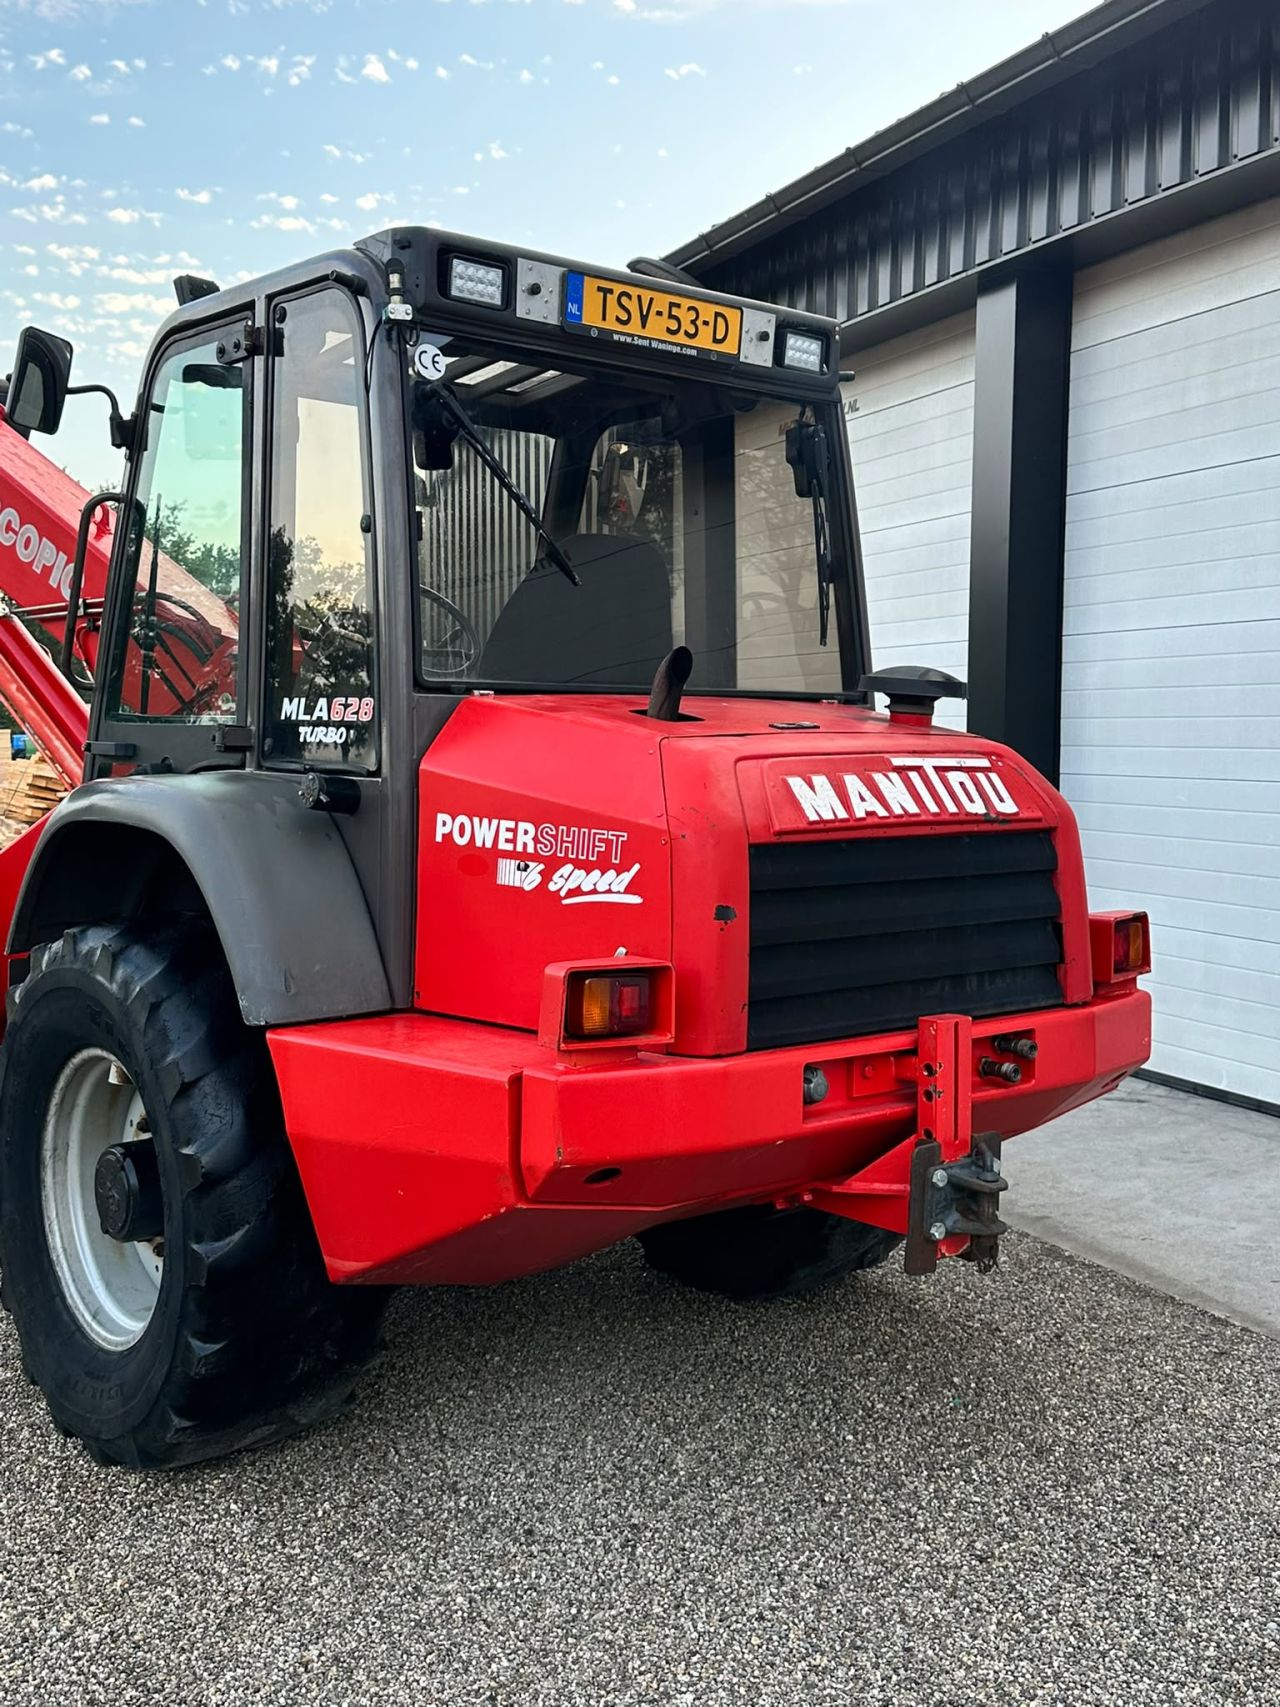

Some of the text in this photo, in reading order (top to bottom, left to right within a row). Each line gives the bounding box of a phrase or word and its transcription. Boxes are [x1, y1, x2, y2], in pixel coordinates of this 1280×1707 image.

[567, 302, 581, 315] NL
[597, 285, 730, 345] TSV-53-D
[418, 350, 442, 373] CE
[280, 697, 375, 722] MLA628
[298, 725, 347, 744] TURBO
[787, 757, 1020, 822] MANITOU
[435, 812, 628, 864] POWERSHIFT
